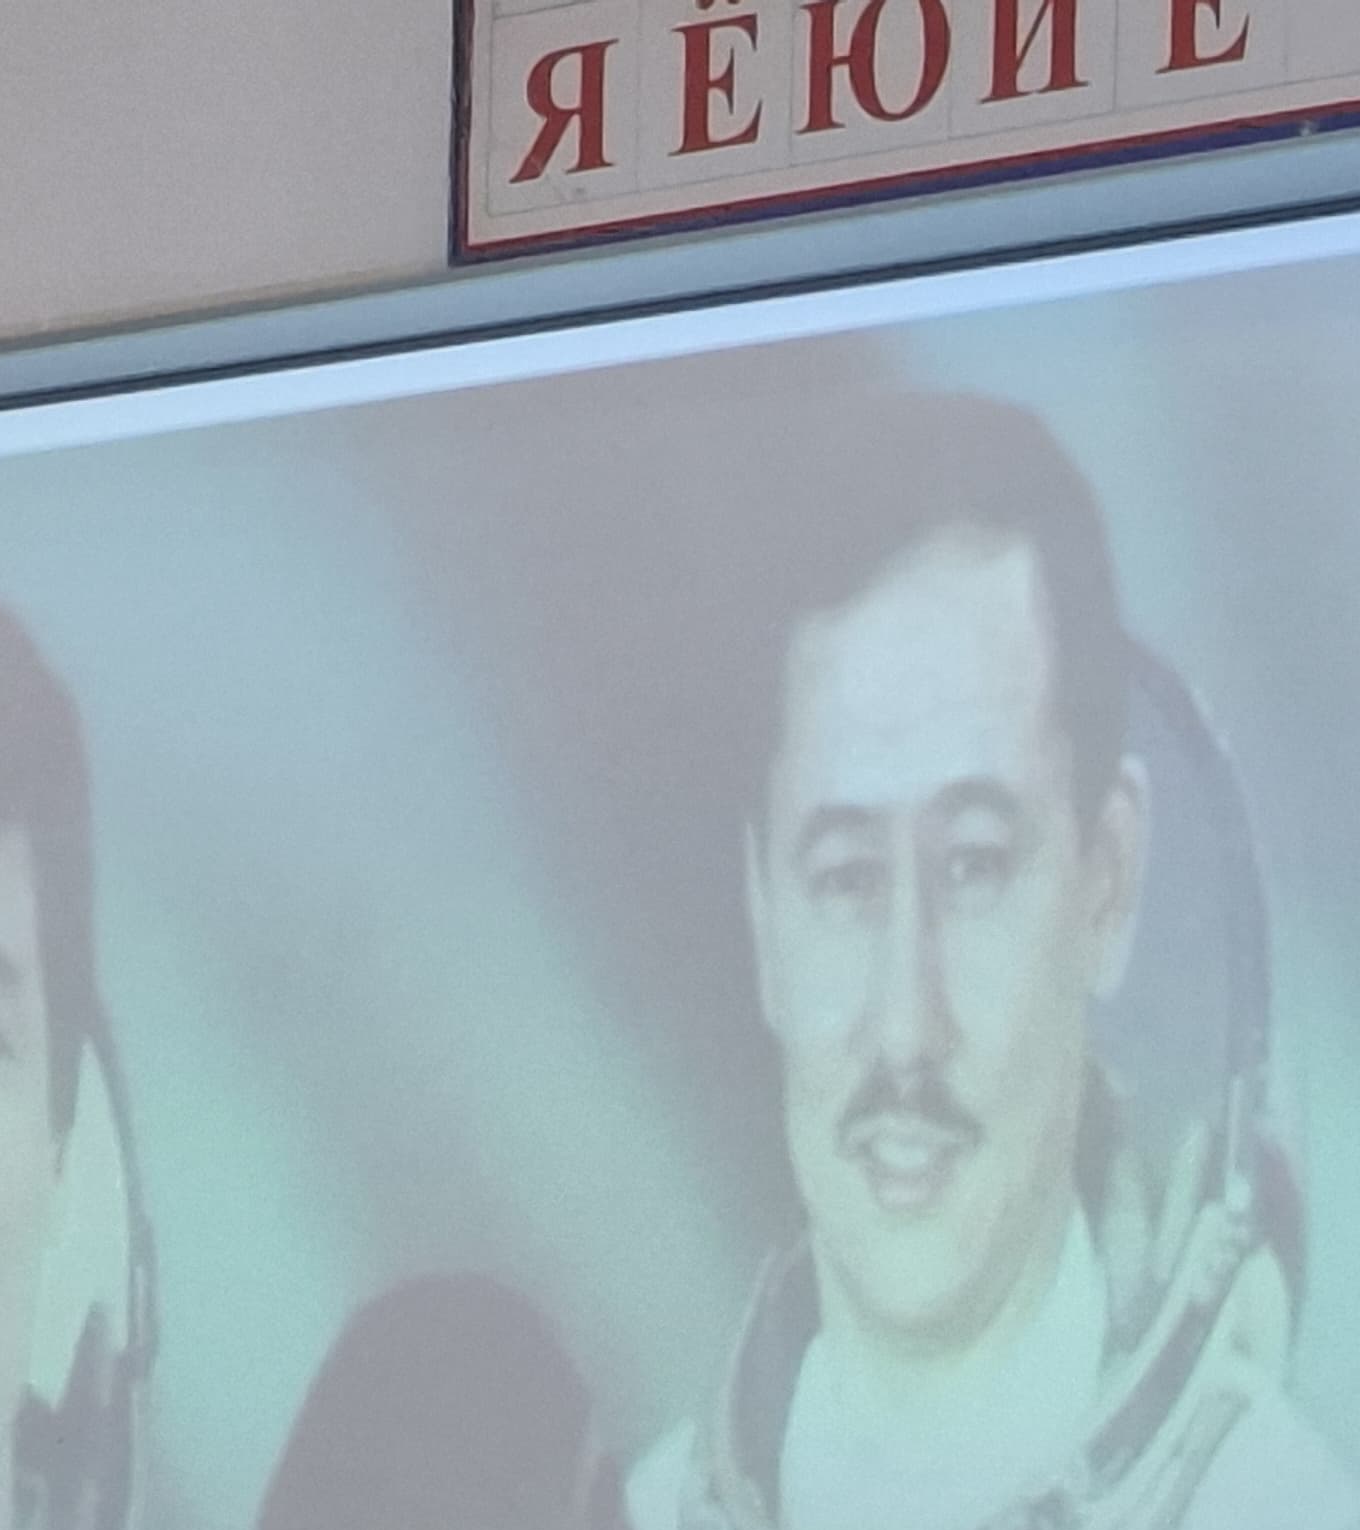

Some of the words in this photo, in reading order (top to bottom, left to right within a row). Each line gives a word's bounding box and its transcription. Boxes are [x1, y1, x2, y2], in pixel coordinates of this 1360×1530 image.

[509, 39, 620, 184] Я
[668, 0, 764, 157] Ё
[795, 0, 951, 135] Ю
